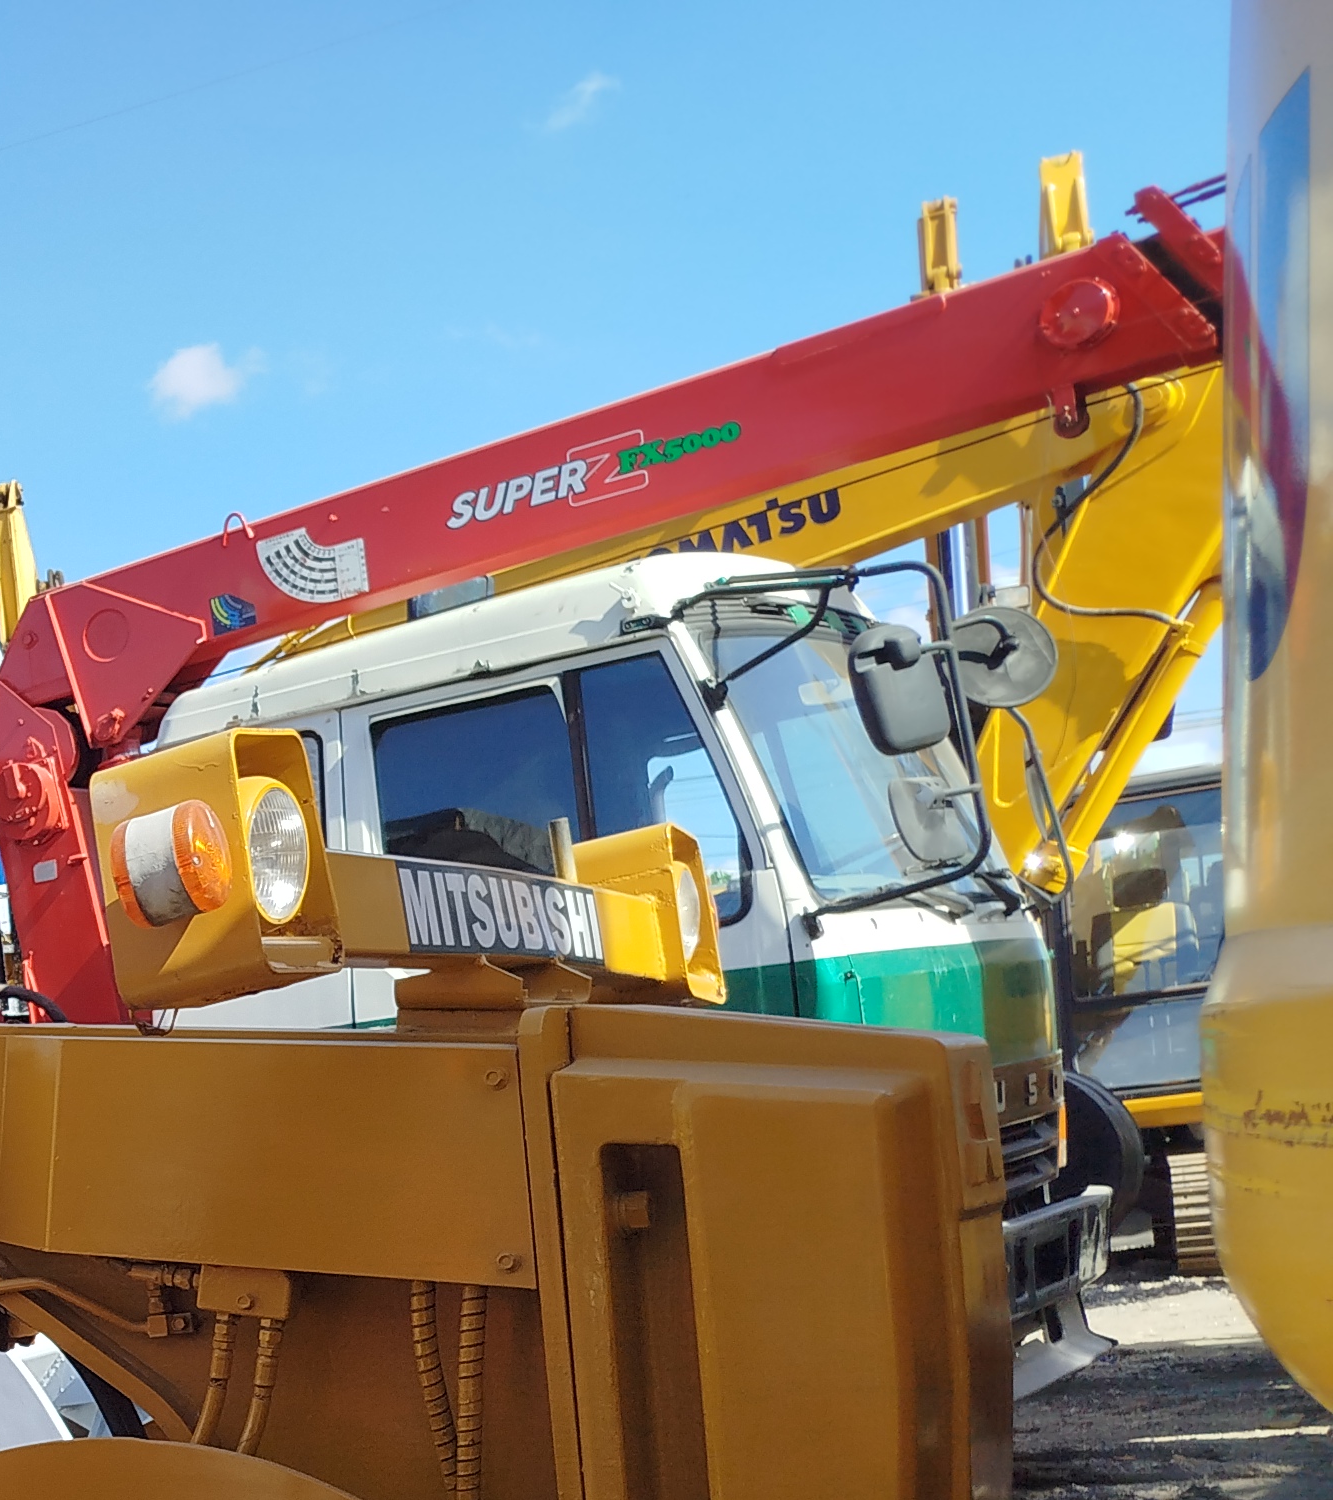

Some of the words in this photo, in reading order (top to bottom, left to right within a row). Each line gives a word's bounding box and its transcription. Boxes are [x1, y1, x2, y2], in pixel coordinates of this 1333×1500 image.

[445, 459, 590, 531] SUPER
[617, 420, 742, 475] FX5000
[627, 487, 842, 561] MATSU
[398, 867, 605, 961] MITSUBISHI
